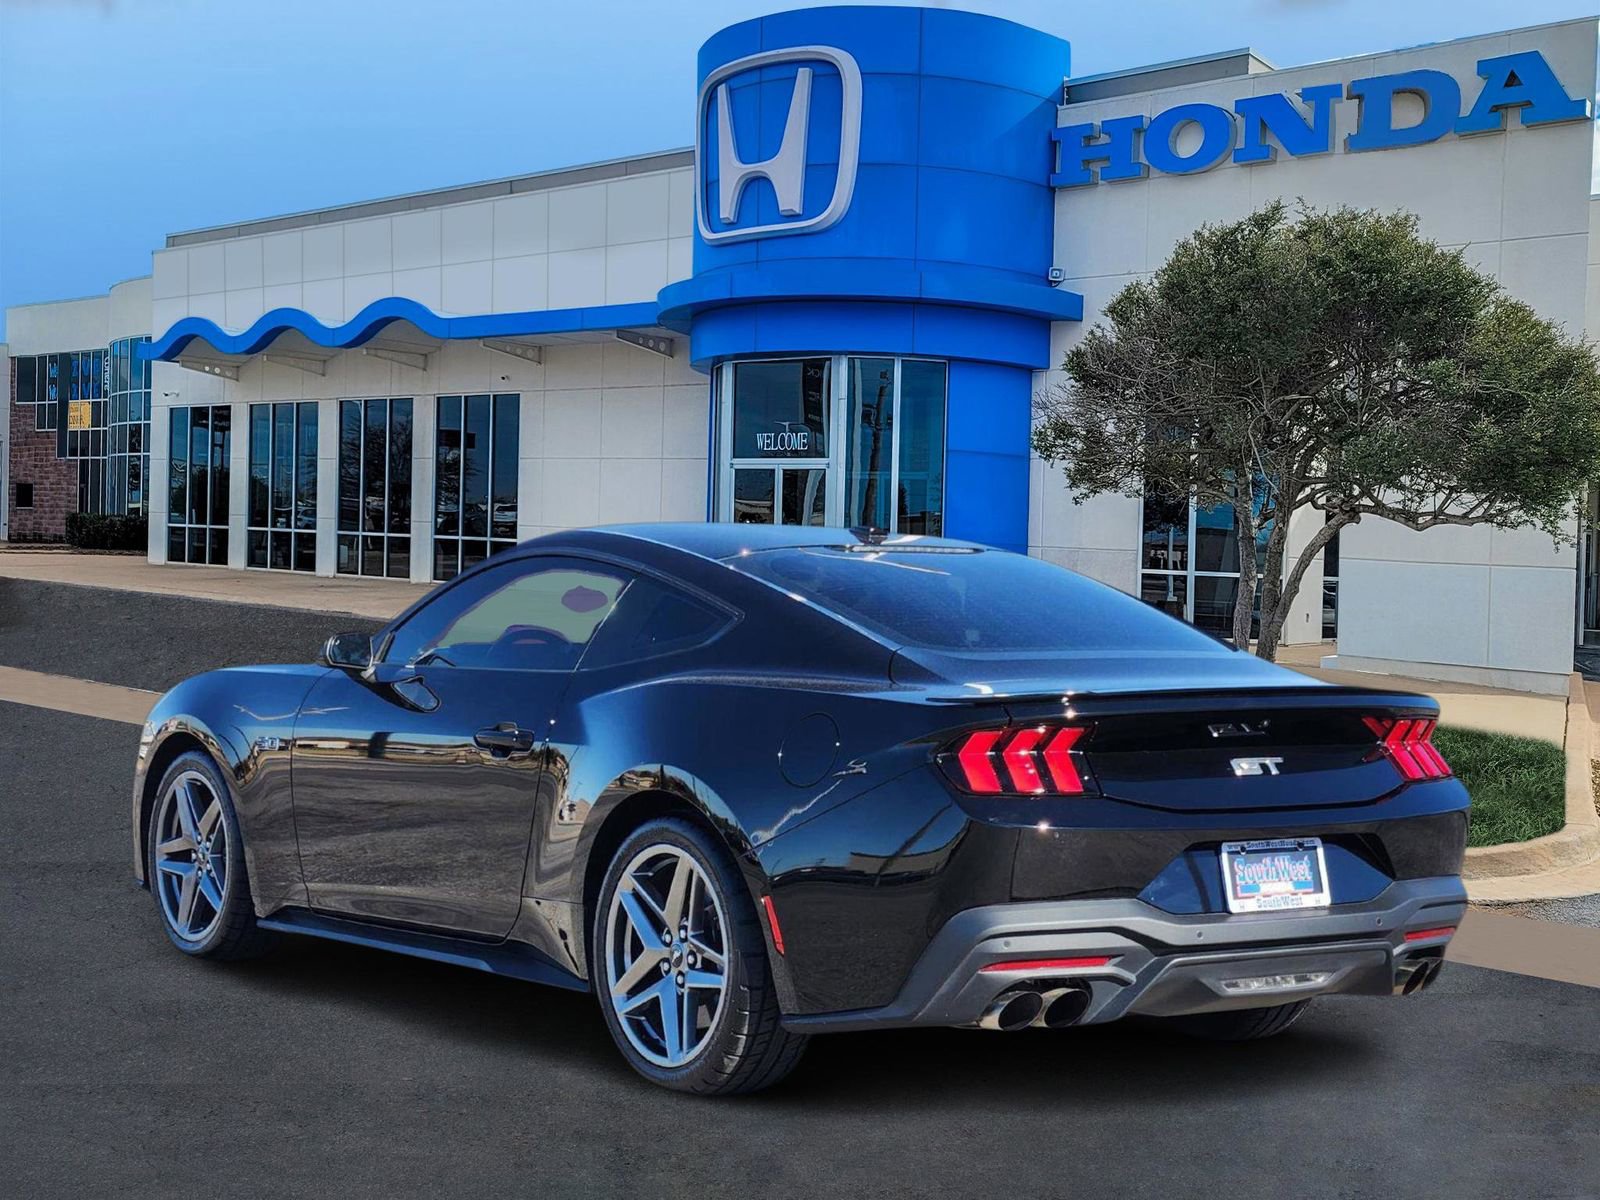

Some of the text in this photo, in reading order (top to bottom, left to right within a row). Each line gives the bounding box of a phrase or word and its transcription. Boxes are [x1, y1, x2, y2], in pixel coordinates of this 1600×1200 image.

[1051, 50, 1590, 188] HONDA
[756, 432, 808, 450] WELCOME
[1230, 757, 1284, 776] GT
[1234, 855, 1313, 883] SouthWest
[1256, 896, 1304, 909] SouthWest
